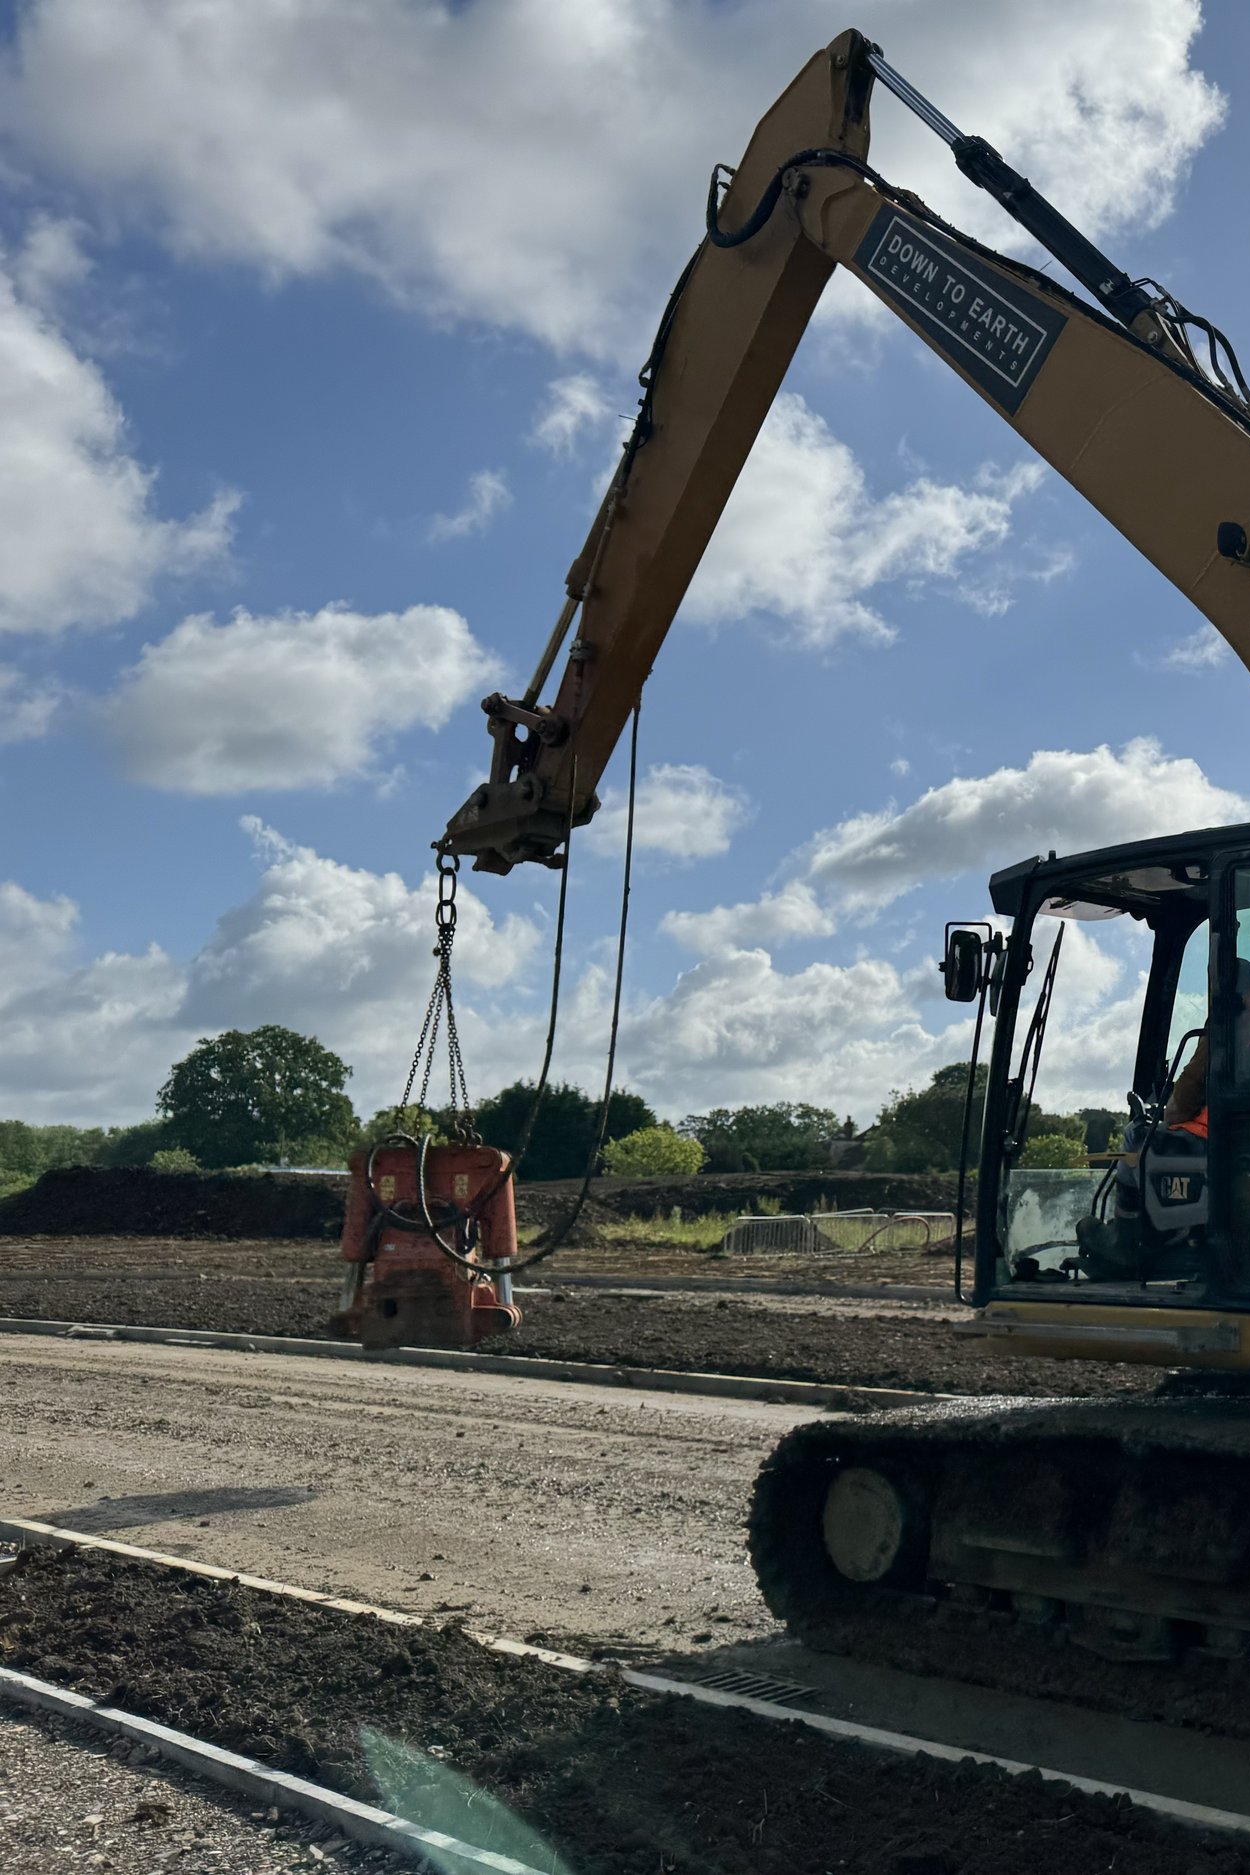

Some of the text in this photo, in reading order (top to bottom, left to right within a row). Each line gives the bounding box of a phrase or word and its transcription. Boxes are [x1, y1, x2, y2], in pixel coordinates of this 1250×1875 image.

[880, 257, 1017, 370] DEVELOPMENTS
[888, 235, 1029, 354] DOWN TO EARTH
[1161, 1176, 1190, 1199] CAT
